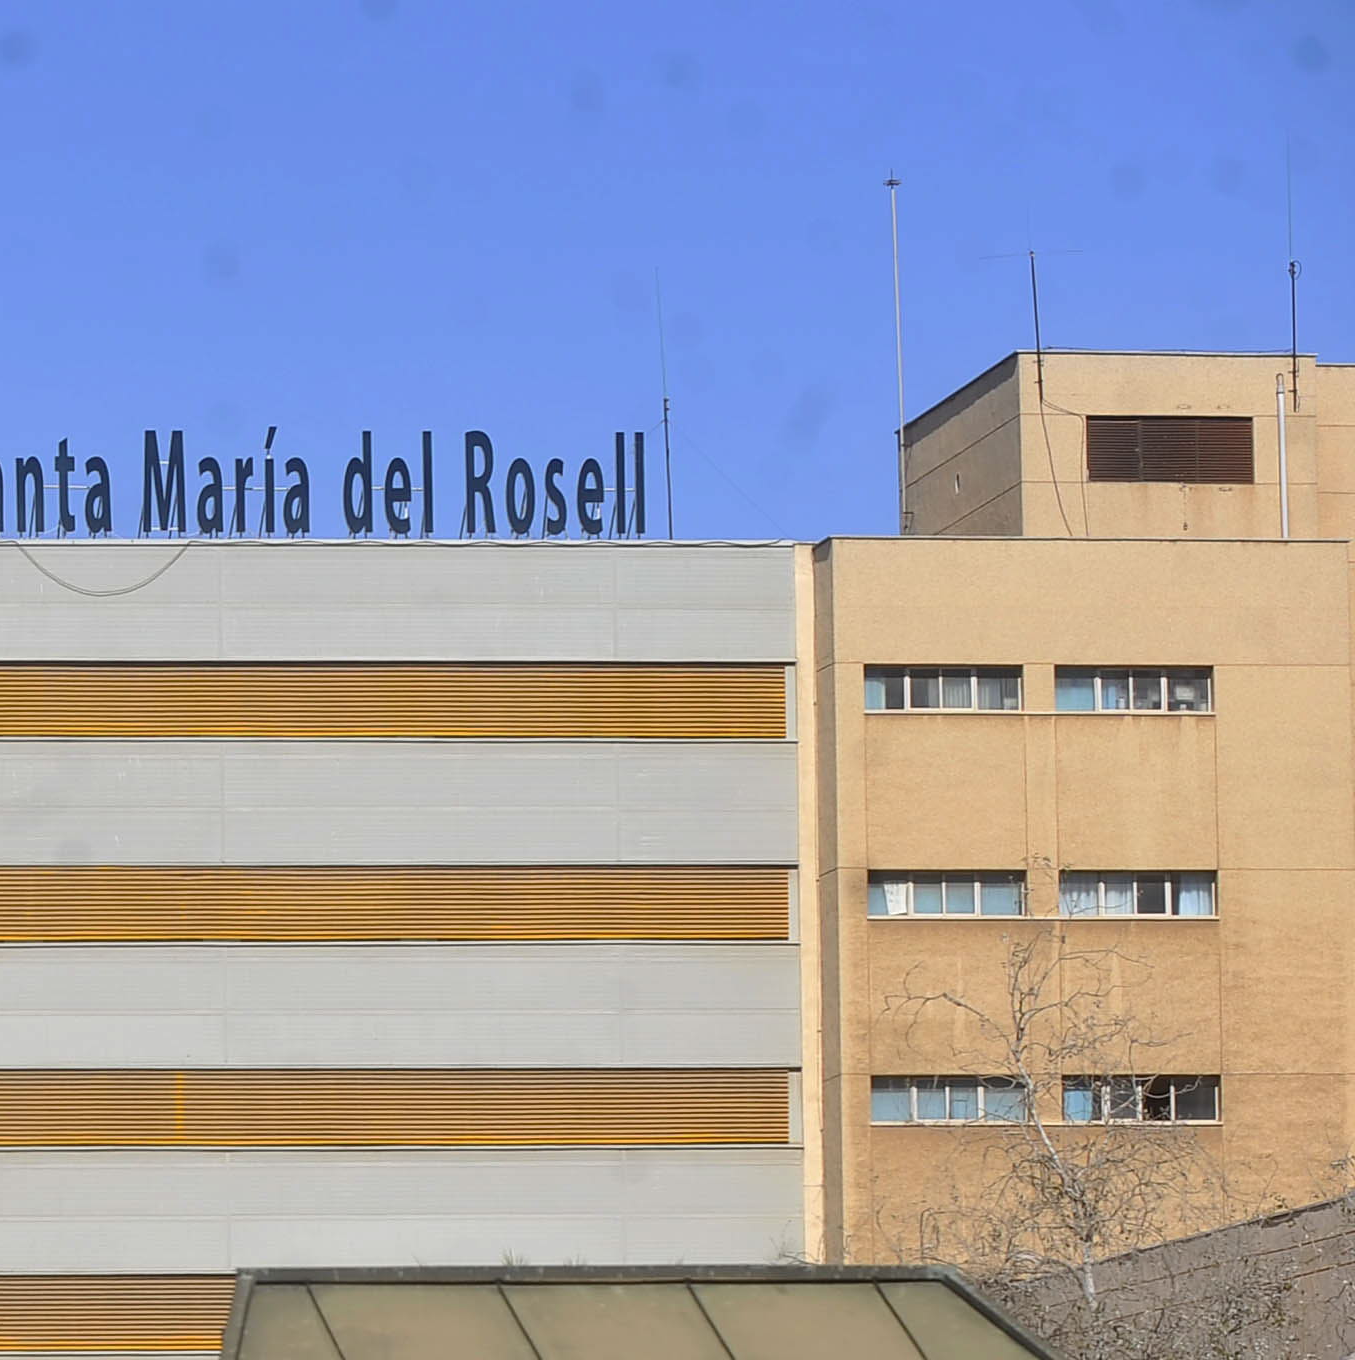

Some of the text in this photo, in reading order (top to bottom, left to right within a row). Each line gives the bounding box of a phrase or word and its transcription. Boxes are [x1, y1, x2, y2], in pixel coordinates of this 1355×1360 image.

[143, 427, 311, 534] María
[344, 431, 433, 534] del
[465, 430, 646, 534] Rosell
